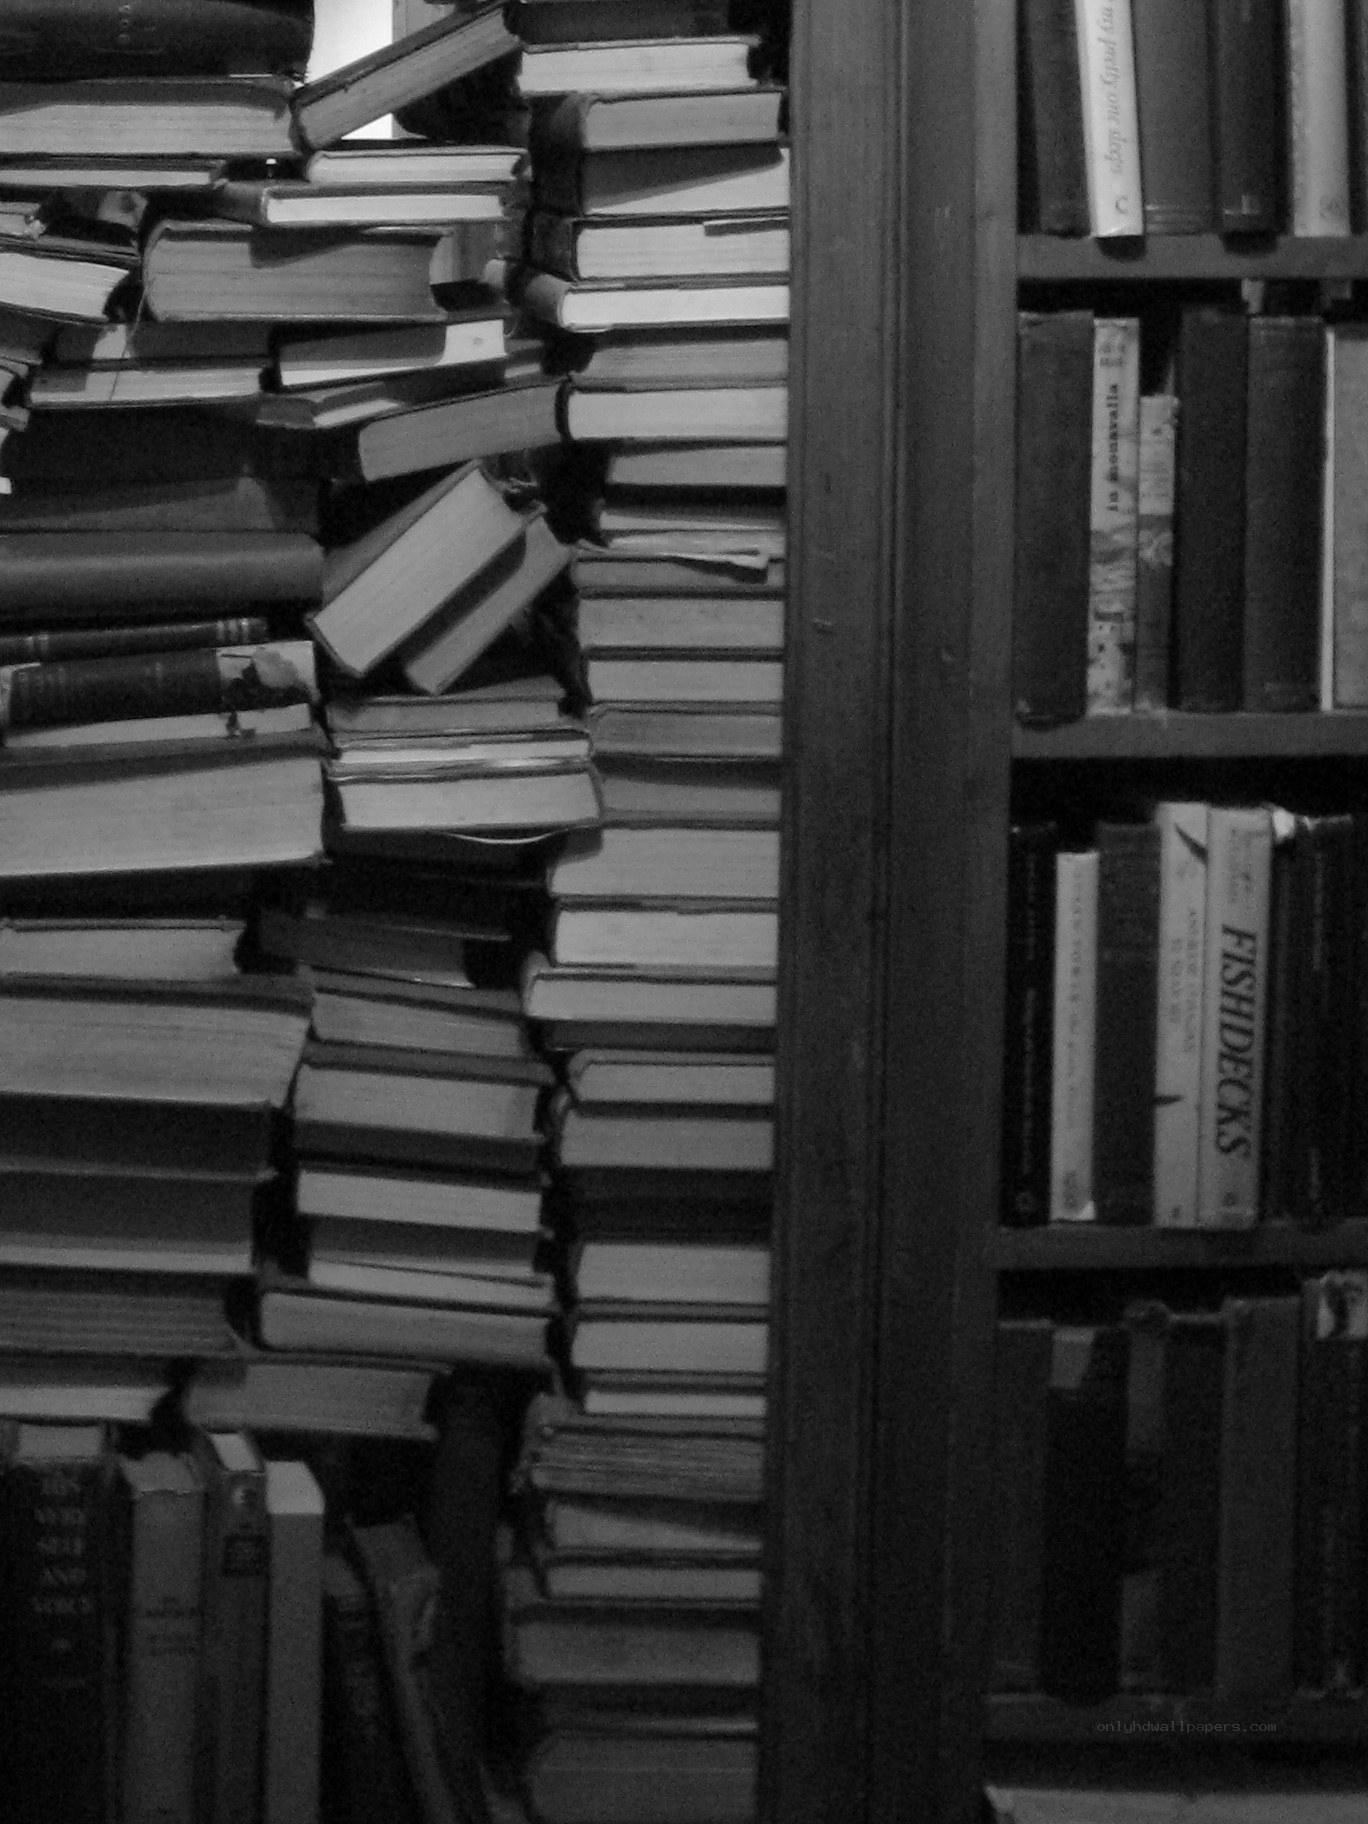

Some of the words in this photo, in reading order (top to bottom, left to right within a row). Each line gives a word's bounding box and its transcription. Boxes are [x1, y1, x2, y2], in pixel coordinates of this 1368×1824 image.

[1103, 7, 1120, 33] my
[1104, 38, 1125, 89] pretty
[1110, 91, 1125, 122] one
[1109, 128, 1131, 174] sleeps
[1216, 924, 1257, 1158] FISHDECKS
